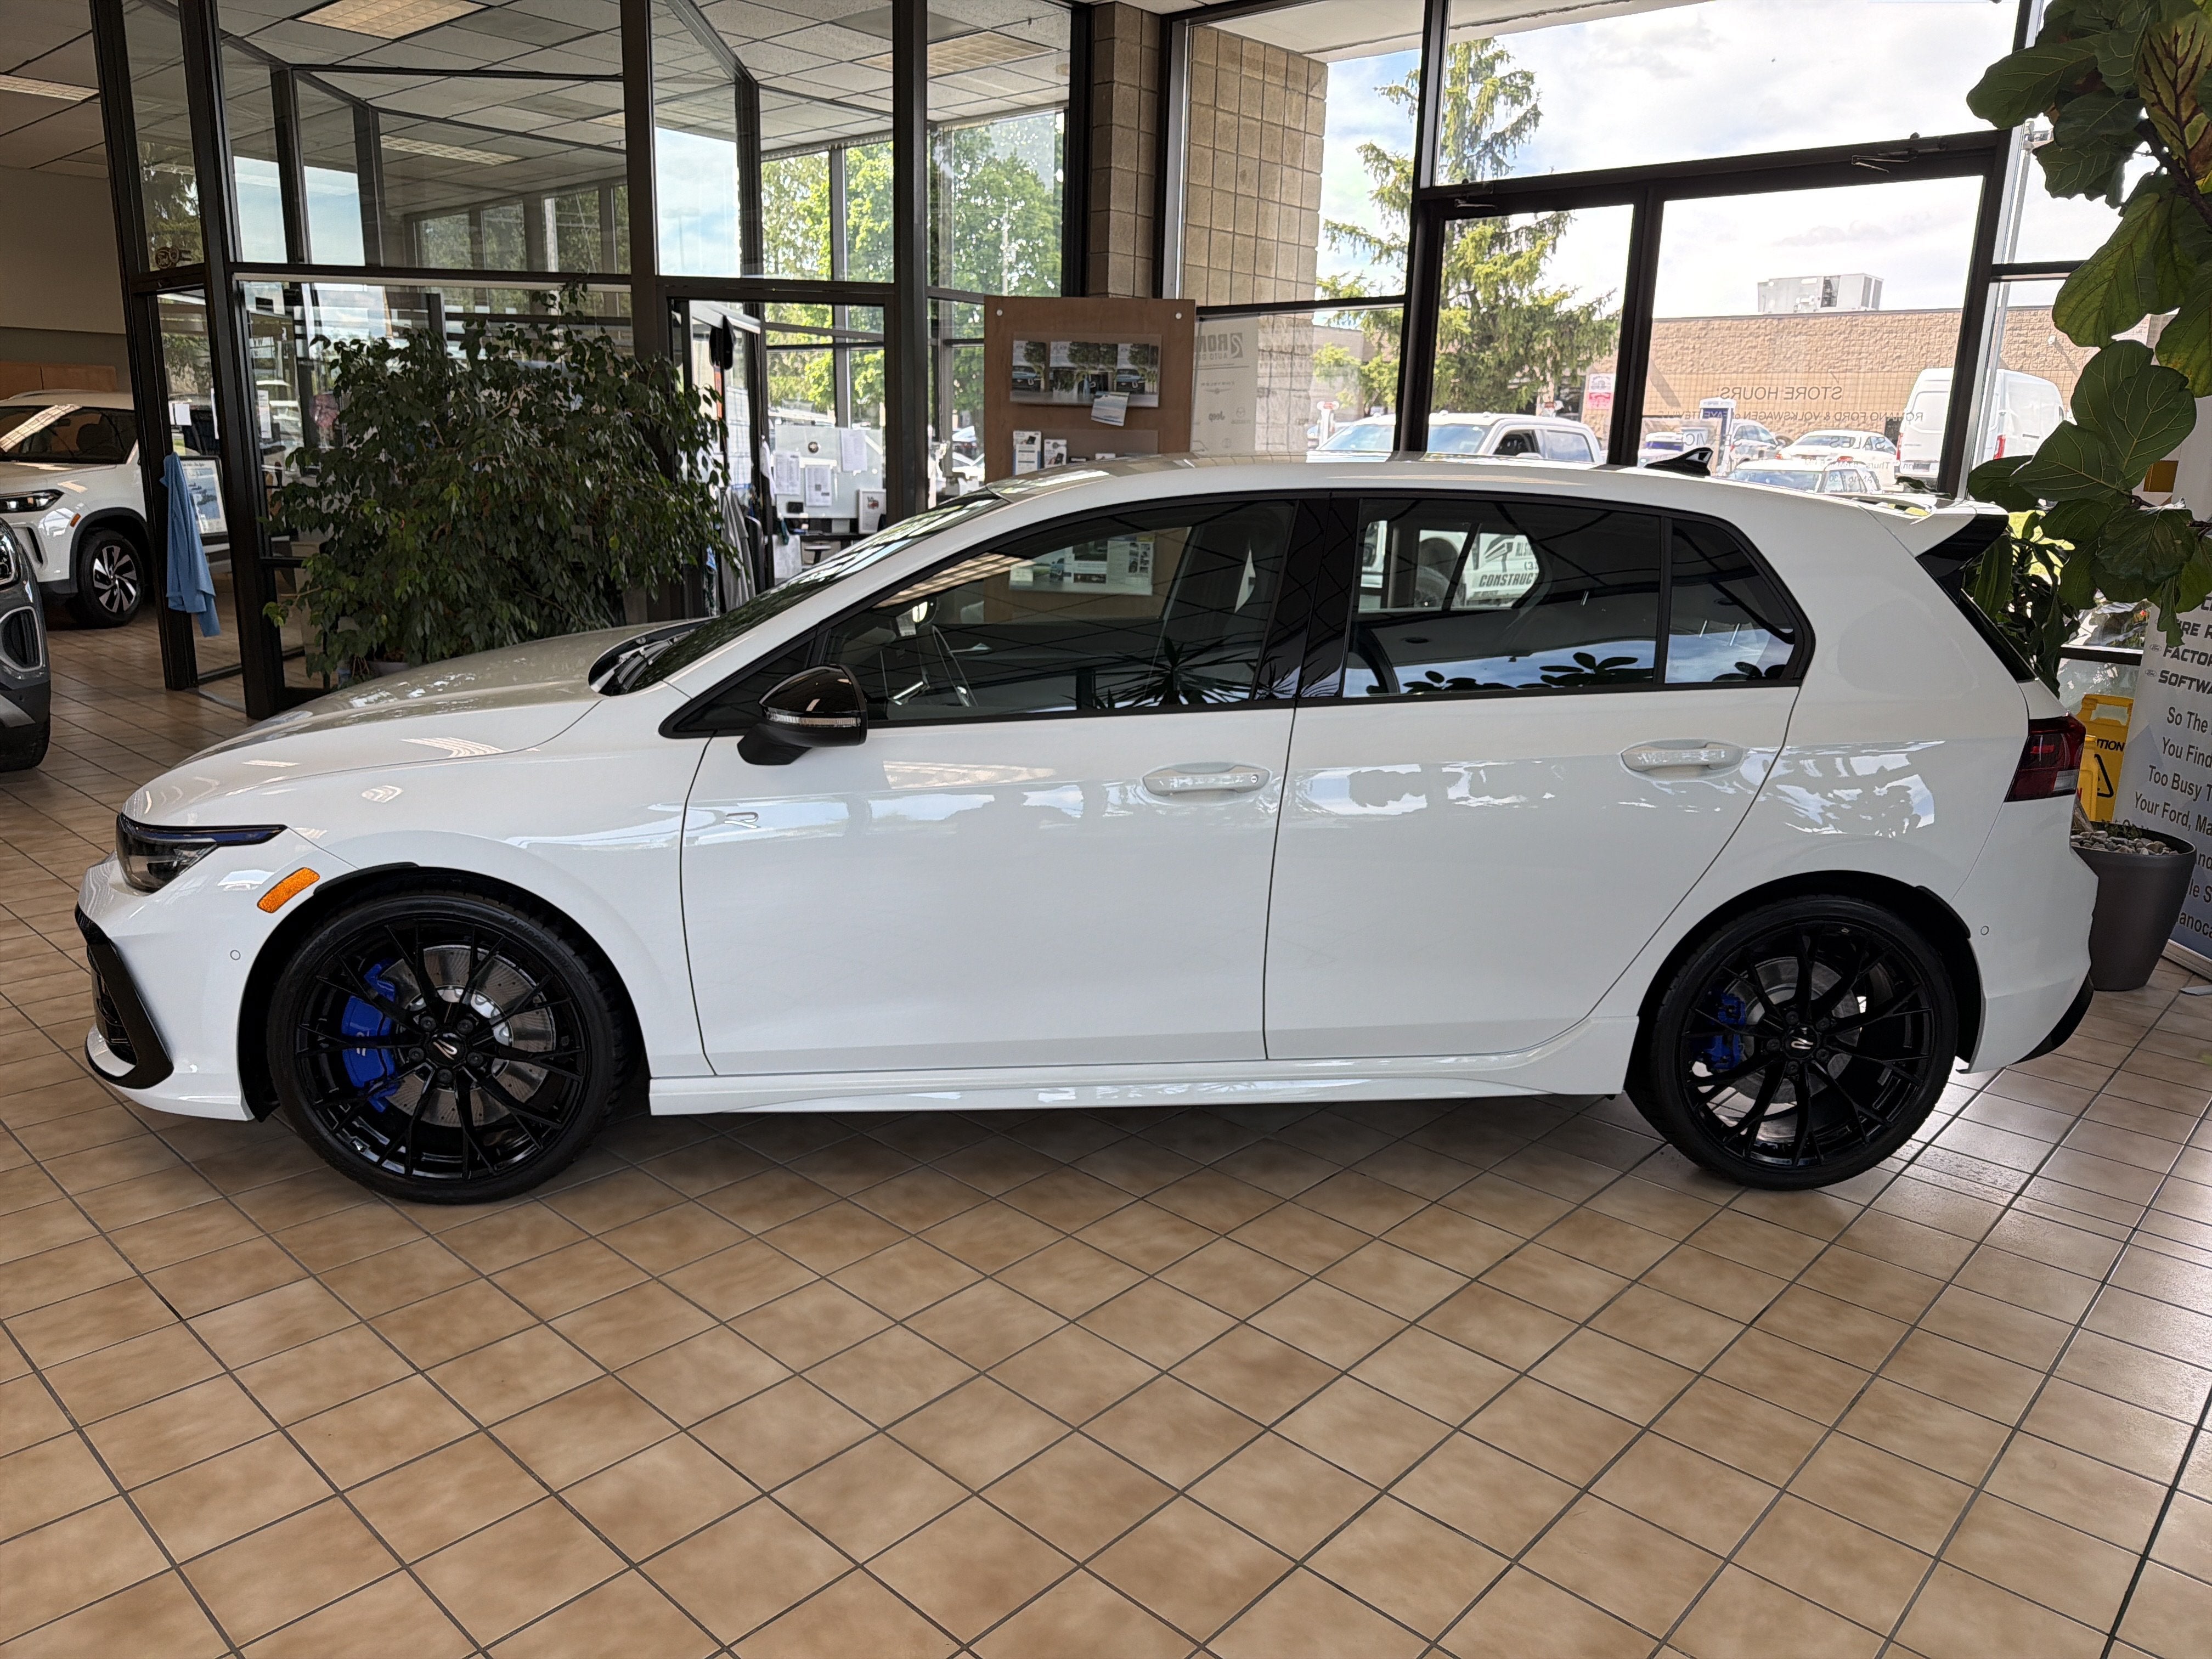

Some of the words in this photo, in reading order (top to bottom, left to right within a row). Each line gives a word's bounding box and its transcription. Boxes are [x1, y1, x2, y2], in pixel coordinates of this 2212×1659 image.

[2167, 706, 2182, 726] So
[2187, 710, 2208, 733] The
[2097, 738, 2125, 752] TION
[2163, 736, 2183, 759] You
[2149, 765, 2168, 786] Too
[2171, 772, 2203, 802] Busy
[2135, 791, 2160, 816] Your
[2161, 802, 2191, 831] Ford,
